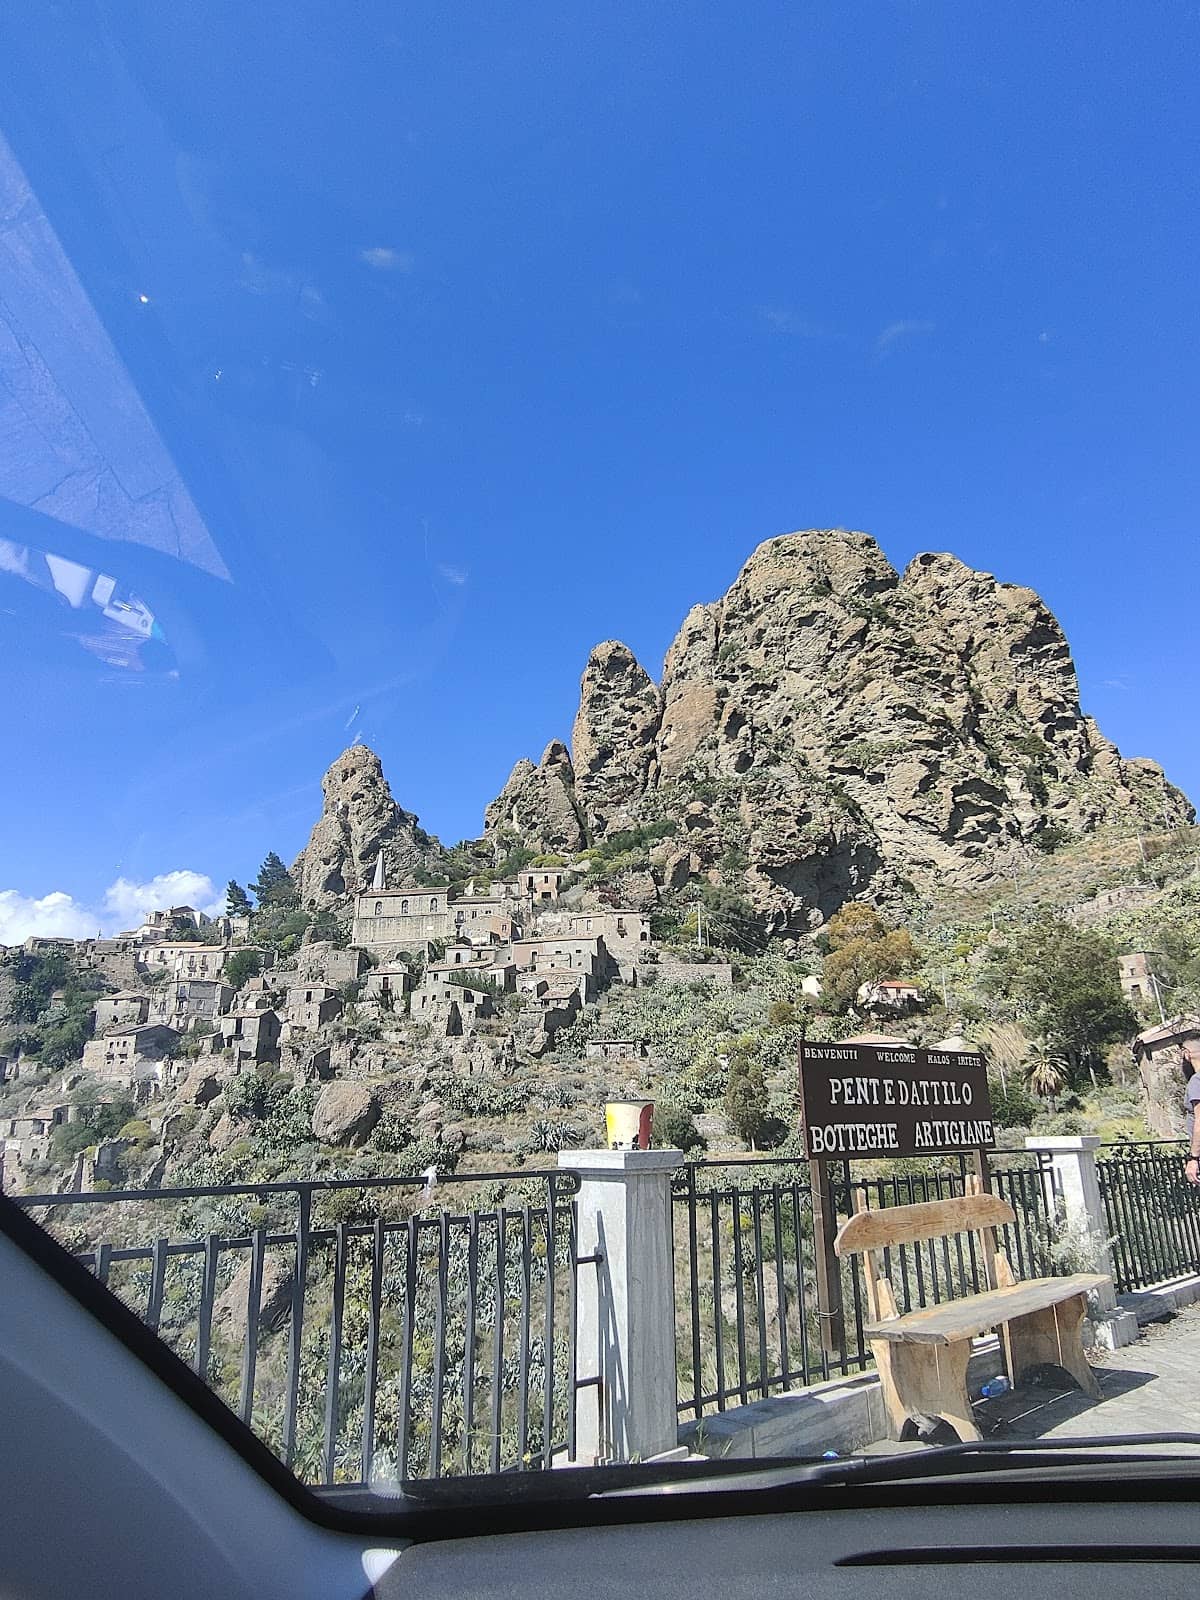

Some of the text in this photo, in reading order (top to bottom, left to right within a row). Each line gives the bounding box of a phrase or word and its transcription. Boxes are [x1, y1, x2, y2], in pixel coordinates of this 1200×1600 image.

[804, 1048, 857, 1060] BENVENUTI
[876, 1051, 916, 1063] WELCOME
[927, 1054, 950, 1065] KALOS
[829, 1077, 973, 1105] PENTEDATTILO
[809, 1120, 994, 1153] BOTTEGHE ARTIGIANE
